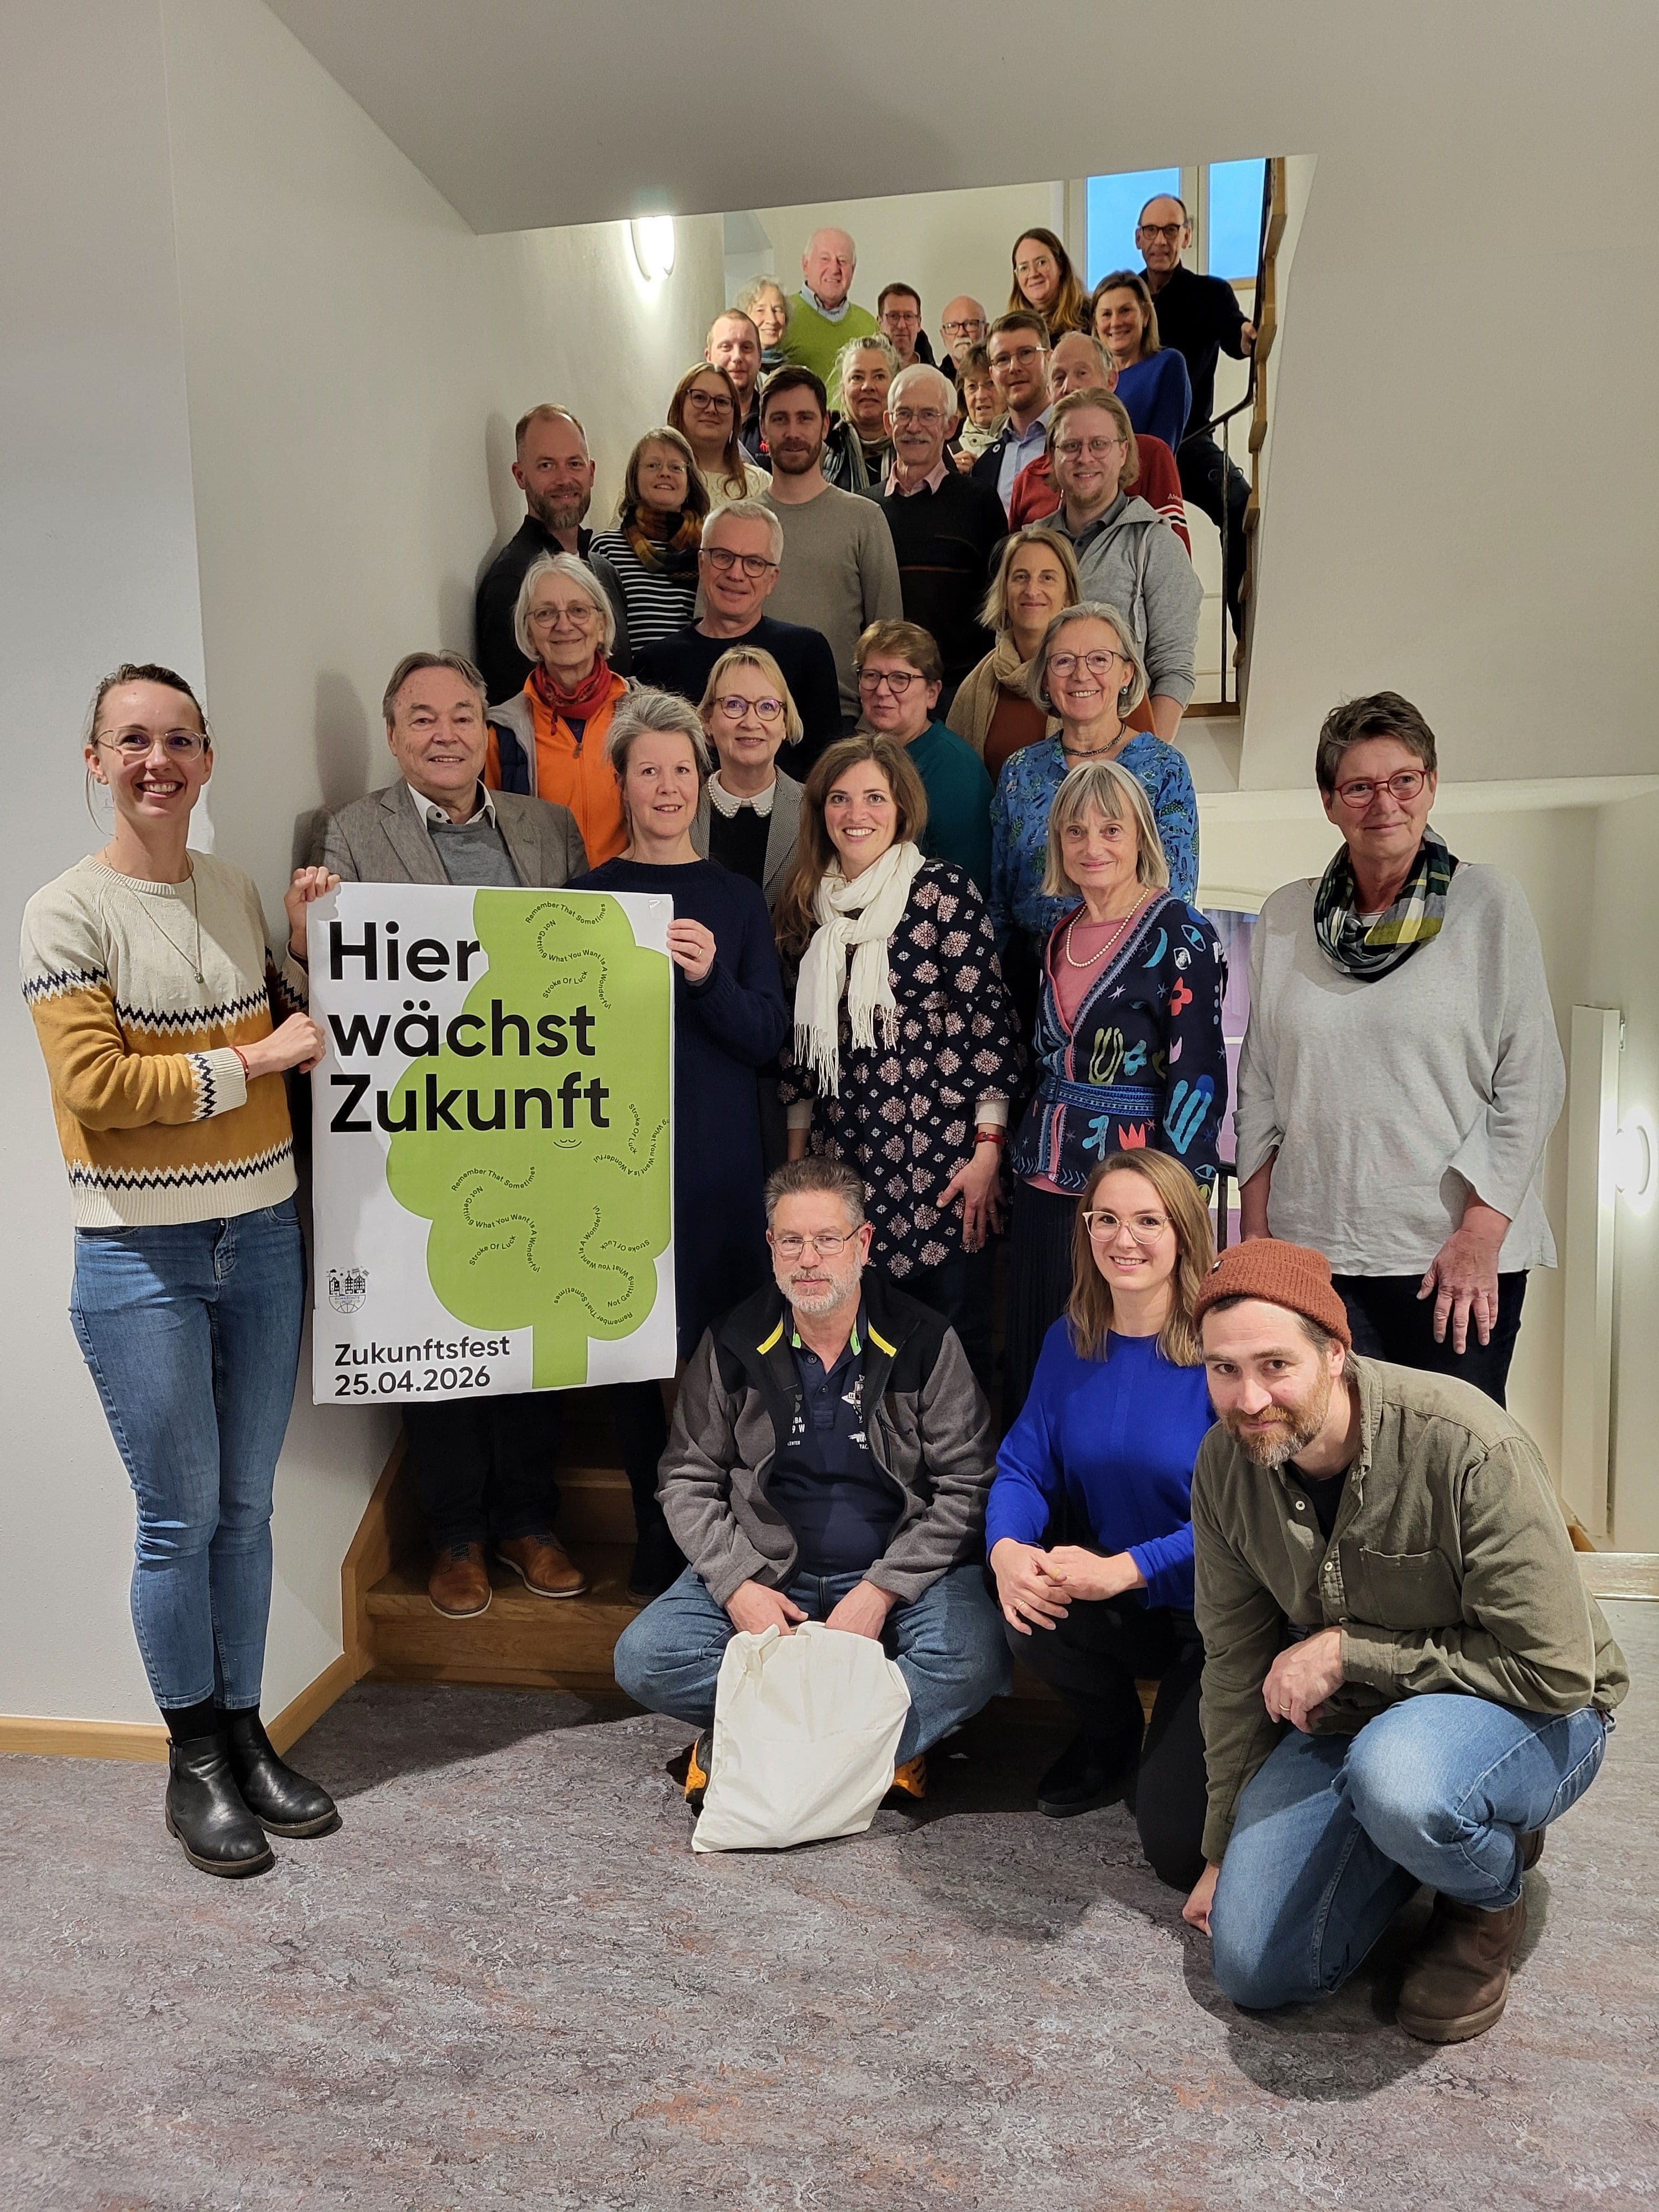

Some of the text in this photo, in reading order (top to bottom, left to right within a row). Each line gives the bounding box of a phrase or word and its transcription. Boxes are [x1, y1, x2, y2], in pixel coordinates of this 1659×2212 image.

[525, 901, 606, 925] Remember That Sometimes
[544, 920, 556, 930] Not
[330, 921, 479, 982] Hier
[537, 931, 547, 958] Getting
[582, 949, 601, 959] Want
[542, 980, 561, 999] Stroke
[574, 971, 588, 984] Luck
[598, 974, 611, 1009] Wonderful
[327, 999, 595, 1057] wächst
[331, 1072, 609, 1132] Zukunft
[628, 1104, 640, 1154] Stroke Of Luck
[651, 1125, 663, 1141] What
[593, 1155, 627, 1172] Wonderful
[641, 1158, 655, 1174] Want
[452, 1166, 535, 1191] Remember That Sometimes
[471, 1186, 483, 1197] Not
[463, 1198, 474, 1225] Getting
[510, 1214, 530, 1223] Want
[583, 1206, 601, 1240] Wonderful
[469, 1246, 488, 1265] Stroke
[502, 1235, 516, 1249] Luck
[527, 1237, 540, 1272] Wonderful
[601, 1240, 617, 1250] Luck
[628, 1239, 650, 1252] Stroke
[581, 1254, 596, 1269] Want
[613, 1265, 628, 1277] What
[621, 1276, 634, 1301] Getting
[554, 1287, 633, 1325] Remember That Sometimes
[336, 1337, 509, 1366] Zukunftsfest
[335, 1366, 489, 1396] 25.04.2026
